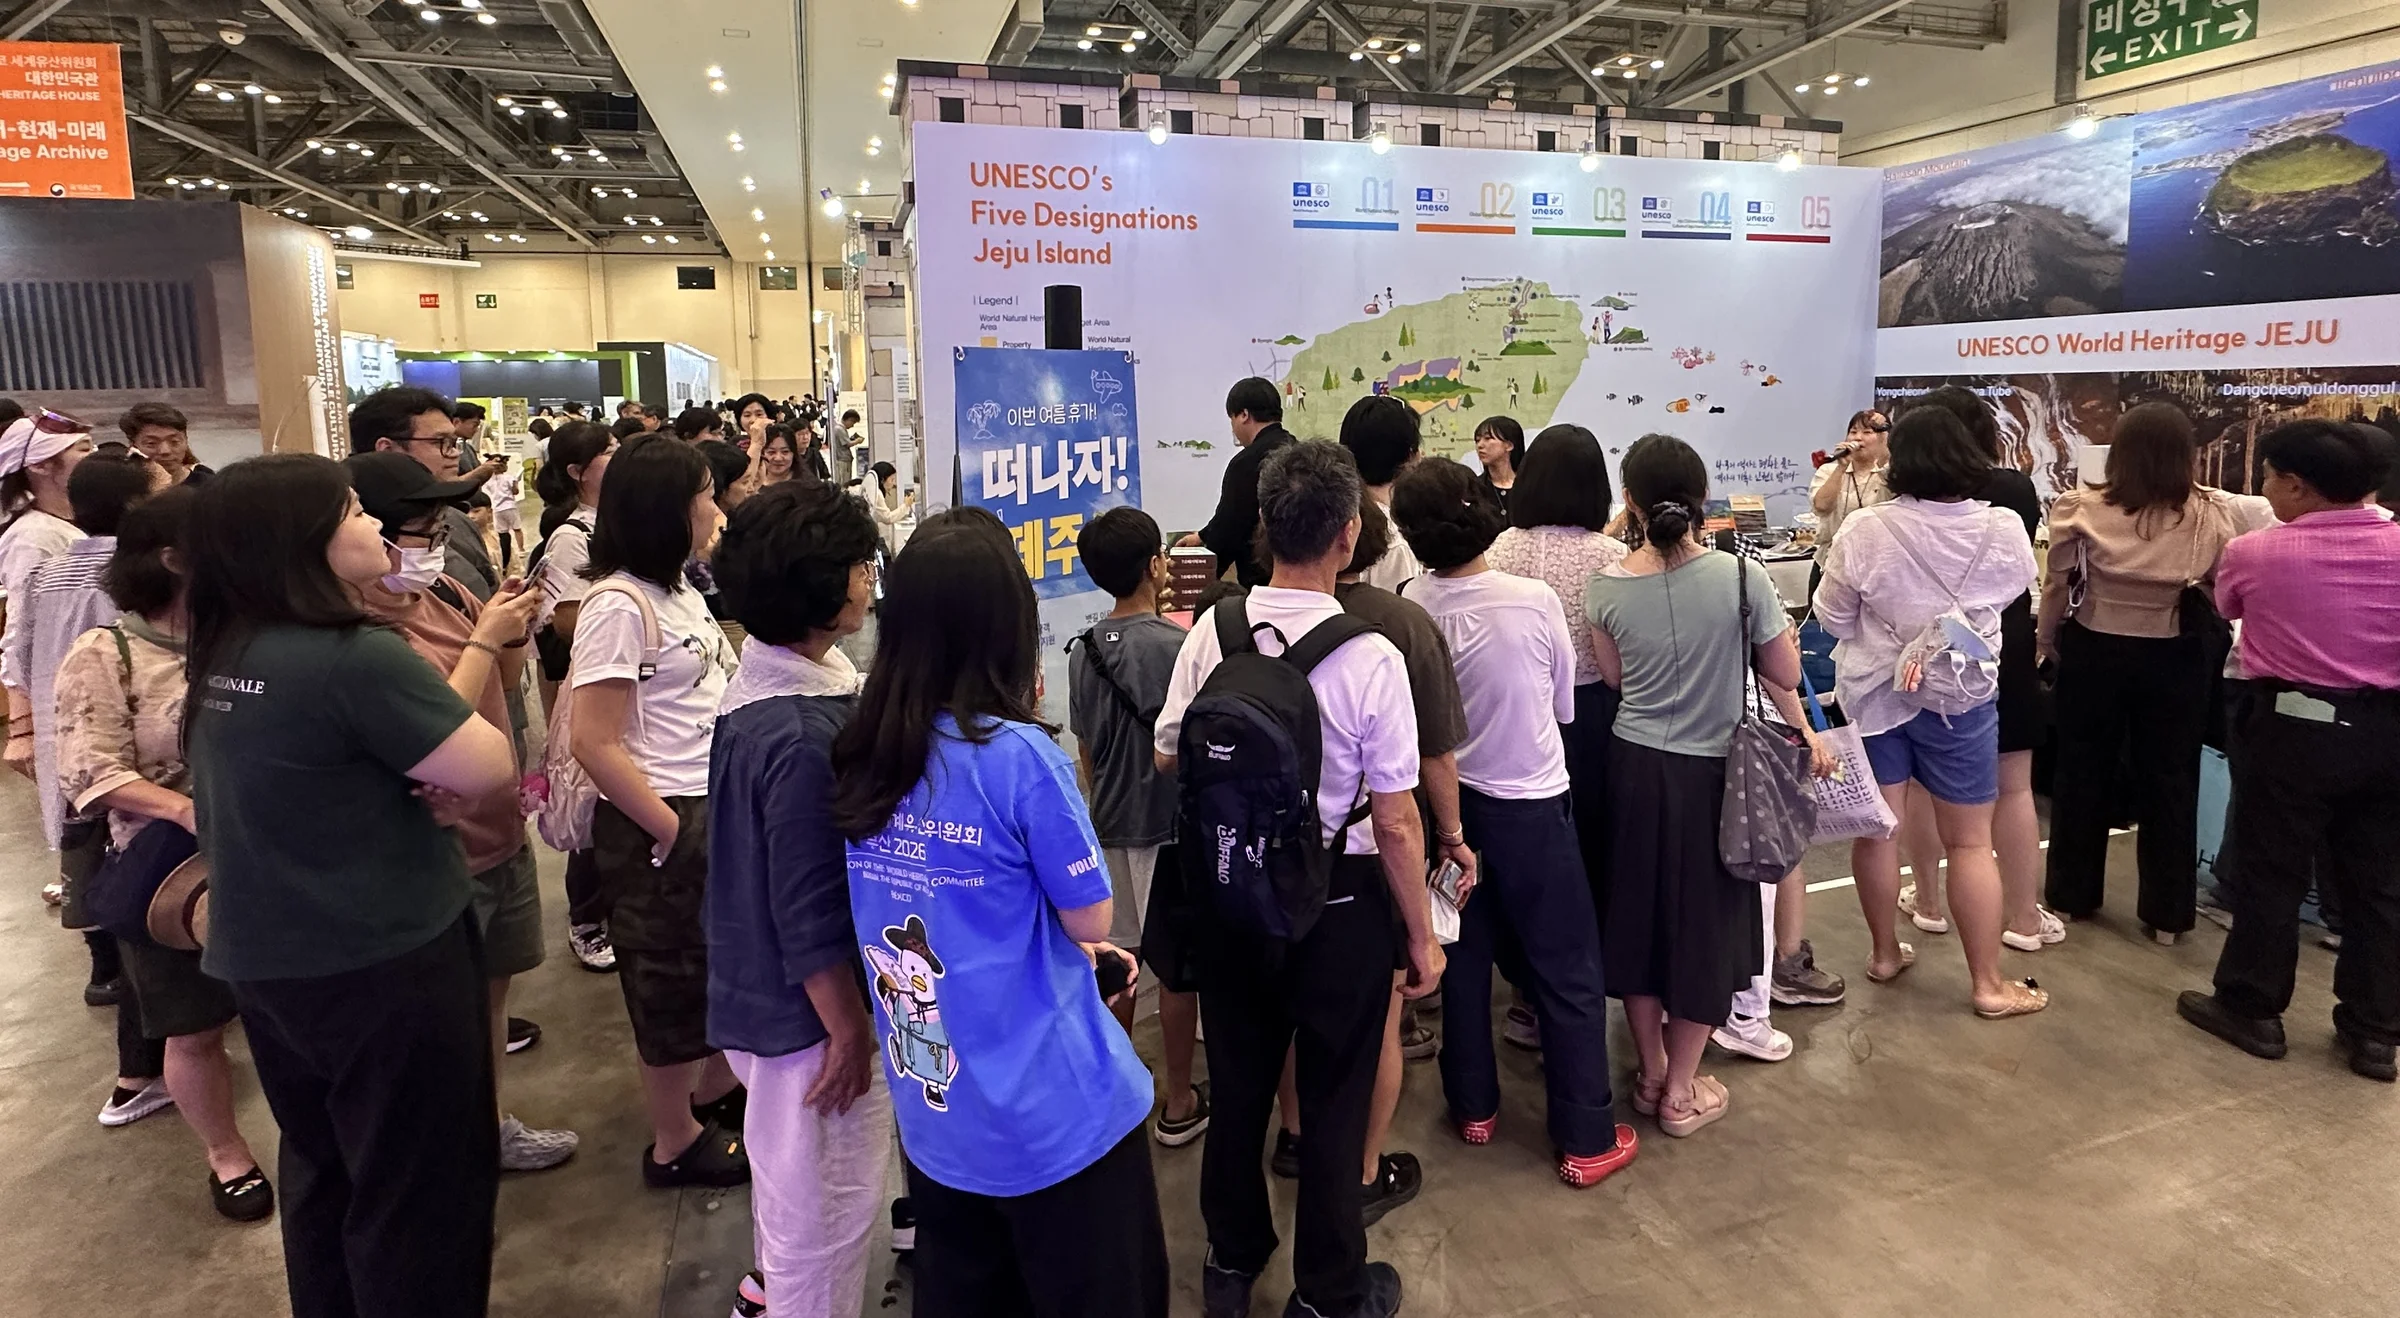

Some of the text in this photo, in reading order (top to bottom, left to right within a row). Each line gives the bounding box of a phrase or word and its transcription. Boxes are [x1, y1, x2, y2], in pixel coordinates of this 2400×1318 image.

[2124, 18, 2212, 64] EXIT
[12, 55, 97, 69] 세계유산위원회
[25, 70, 99, 87] 대한민국관
[0, 90, 100, 101] HERITAGE HOUSE
[36, 144, 109, 159] Archive
[970, 162, 1113, 191] UNESCO's
[1362, 177, 1394, 211] 01
[1481, 182, 1515, 219] 02
[1293, 199, 1330, 208] unesco
[1416, 203, 1449, 212] unesco
[1532, 208, 1563, 216] unesco
[1593, 187, 1626, 221] 03
[1699, 191, 1731, 223] 04
[971, 200, 1198, 234] Five Designations
[1642, 211, 1671, 219] unesco
[1746, 215, 1775, 223] unesco
[1801, 195, 1830, 230] 05
[973, 238, 1111, 269] Jeju Island
[979, 296, 1013, 306] Legend
[979, 314, 1001, 322] World
[1002, 314, 1028, 322] Natural
[980, 323, 998, 331] Area
[1002, 341, 1032, 349] Property
[1957, 318, 2339, 358] UNESCO World Heritage JEJU
[321, 318, 335, 400] INTANGIBLE
[329, 402, 340, 461] CULTURA
[1986, 386, 2012, 396] Tube
[2222, 381, 2396, 399] Dangcheomuldonggul
[1007, 402, 1098, 427] 이번 여름 휴가!
[982, 436, 1129, 506] 떠나자!
[893, 838, 927, 861] 2026
[930, 876, 985, 888] COMMITTEE
